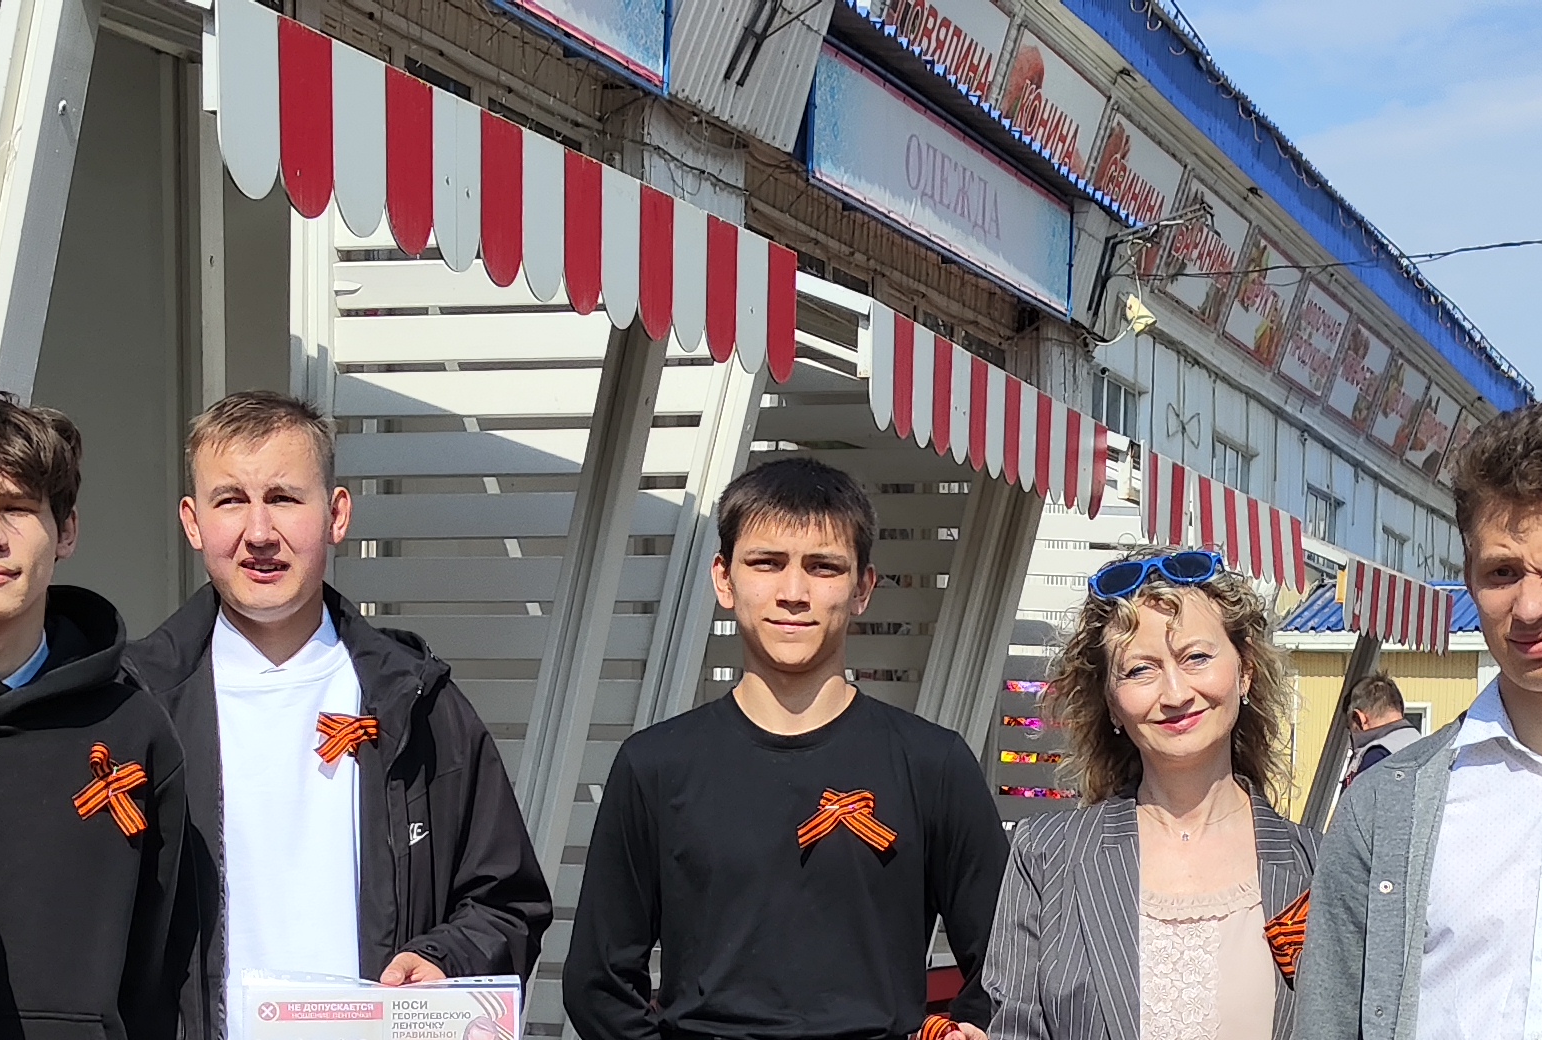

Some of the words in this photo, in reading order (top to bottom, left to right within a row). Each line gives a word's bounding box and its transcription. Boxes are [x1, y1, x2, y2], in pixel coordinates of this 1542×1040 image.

[1014, 79, 1080, 168] КОНИНА
[905, 134, 1001, 242] ОДЕЖДА
[1101, 153, 1165, 222] СВИНИНА
[287, 1003, 302, 1011] НЕ
[303, 1003, 374, 1012] ДОПУСКАЕТСЯ
[392, 1000, 428, 1010] НОСИ
[392, 1011, 471, 1020] ГЕОРГИЕВСКУЮ
[392, 1021, 445, 1030] ЛЕНТОЧКУ
[392, 1031, 457, 1039] ПРАВИЛЬНО!
